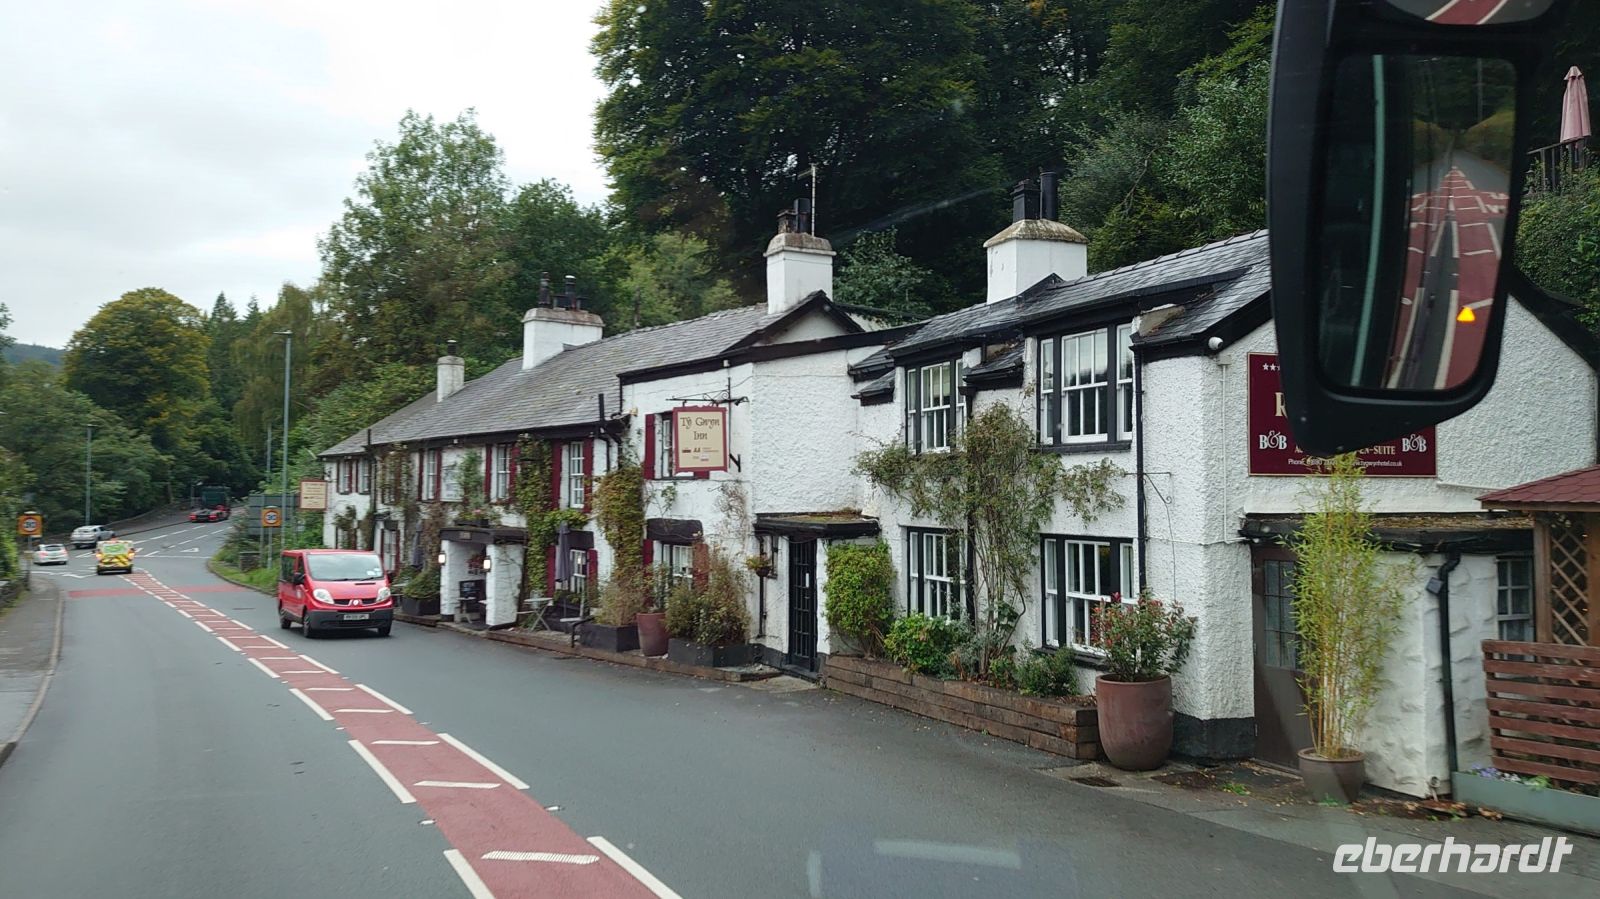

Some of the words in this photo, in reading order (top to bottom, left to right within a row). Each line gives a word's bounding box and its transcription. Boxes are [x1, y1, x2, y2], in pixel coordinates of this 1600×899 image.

[695, 417, 720, 429] Gwyn
[693, 431, 708, 440] Inn
[1259, 430, 1287, 450] B&B
[1402, 434, 1427, 452] B&B
